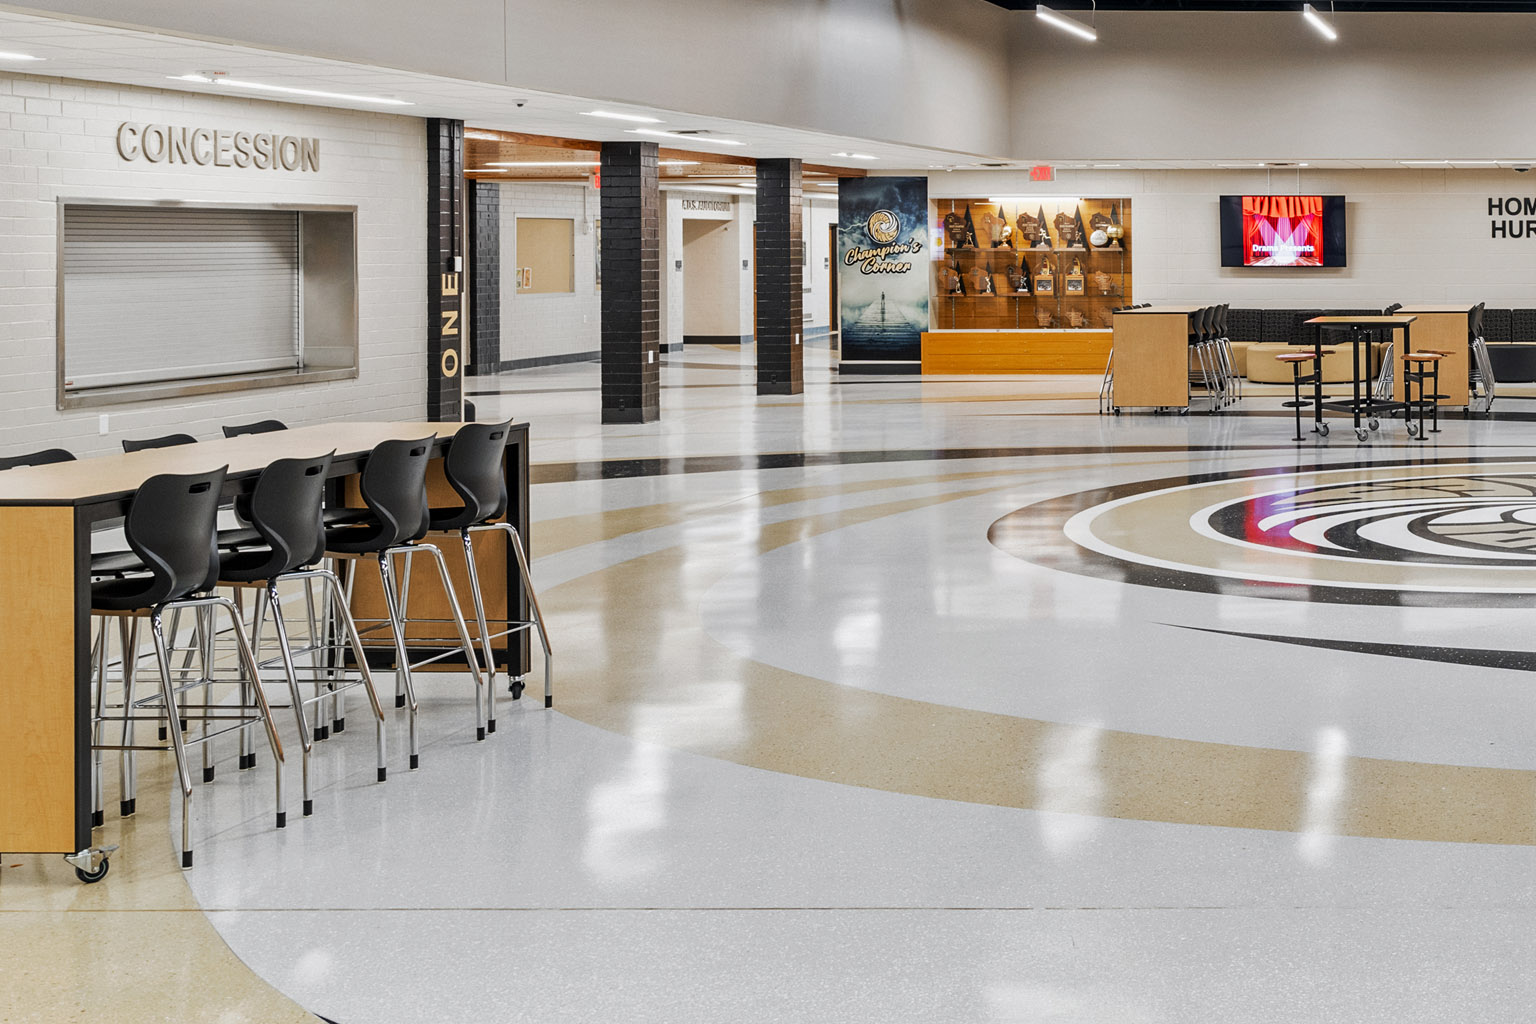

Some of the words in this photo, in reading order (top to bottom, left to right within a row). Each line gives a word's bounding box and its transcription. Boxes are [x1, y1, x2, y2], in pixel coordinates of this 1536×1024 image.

[116, 120, 320, 173] CONCESSION
[844, 237, 923, 266] Champion's
[861, 256, 912, 275] Corner
[441, 272, 459, 378] ONE
